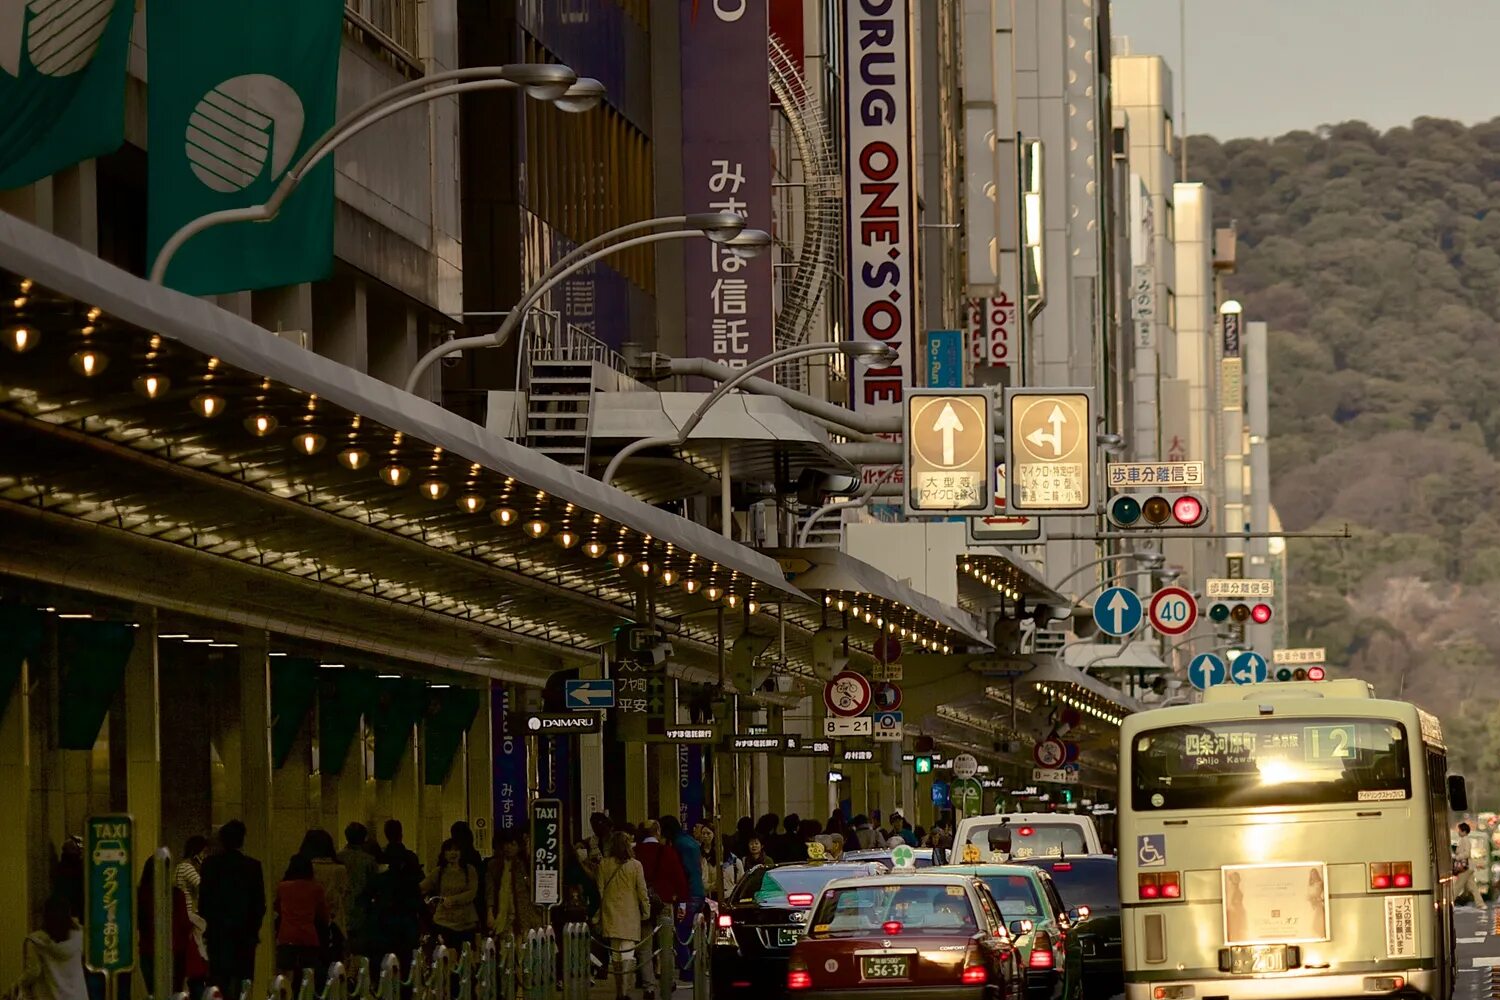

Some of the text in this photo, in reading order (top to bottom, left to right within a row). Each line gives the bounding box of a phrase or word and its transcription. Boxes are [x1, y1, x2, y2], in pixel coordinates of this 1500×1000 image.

[991, 292, 1008, 366] doco
[1112, 466, 1199, 483] 歩車分離信号
[1160, 601, 1187, 621] 40
[618, 699, 648, 712] 平安
[543, 718, 594, 728] DAIMARU
[1186, 733, 1256, 755] 四条河原町
[1196, 757, 1219, 765] Shijo
[501, 783, 514, 829] みずほ
[535, 808, 557, 818] TAXI
[92, 824, 127, 838] TAXI
[547, 824, 557, 869] タクシ
[874, 964, 906, 976] 56-37
